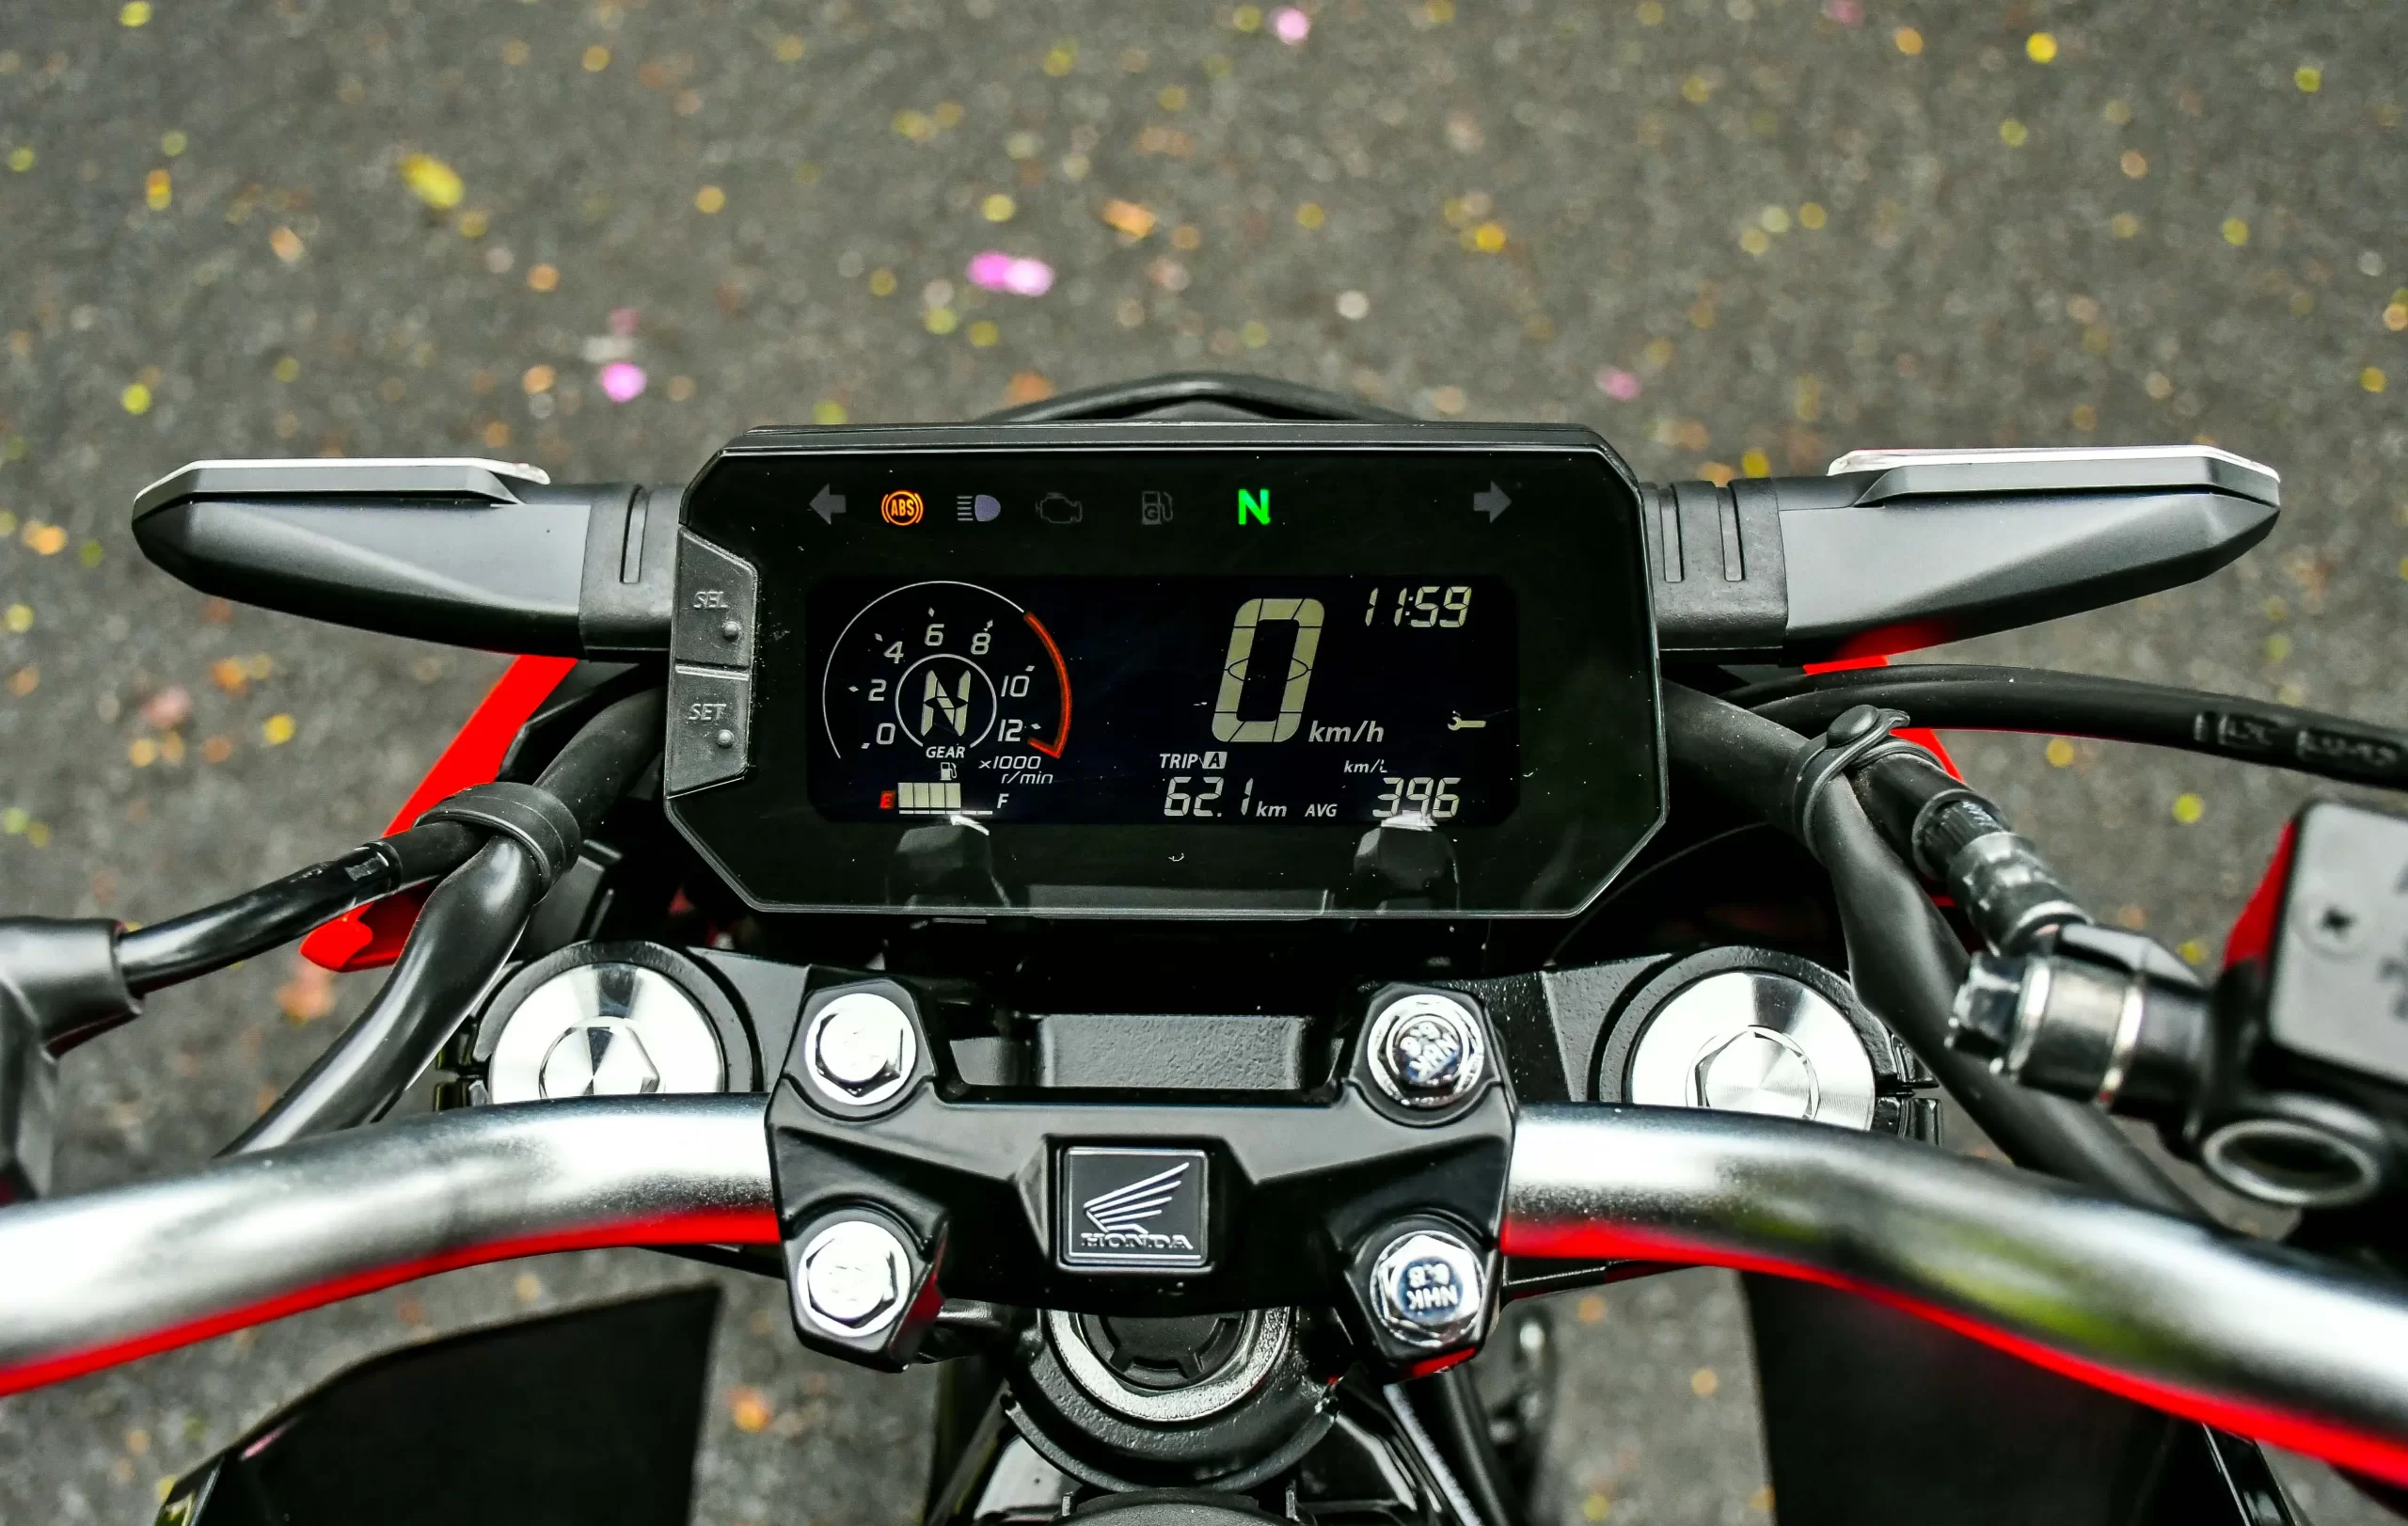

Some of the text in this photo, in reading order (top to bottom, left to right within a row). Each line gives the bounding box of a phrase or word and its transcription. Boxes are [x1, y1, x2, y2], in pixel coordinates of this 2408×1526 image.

[890, 499, 915, 517] ABS
[1239, 489, 1270, 525] N
[692, 590, 730, 610] SEL
[1366, 586, 1471, 628] 11:59
[925, 624, 943, 645] 6
[971, 633, 990, 654] 8
[884, 642, 903, 663] 4
[1212, 598, 1384, 742] 0 km/h
[869, 679, 886, 701] 2
[1001, 676, 1029, 697] 10
[687, 703, 727, 723] SET
[921, 671, 971, 736] N
[877, 723, 895, 744] 0
[998, 720, 1022, 741] 12
[927, 746, 965, 758] GEAR
[979, 756, 1041, 769] x1000
[1160, 753, 1225, 769] TRIP A
[1002, 771, 1053, 784] r/min
[879, 791, 895, 809] E
[997, 794, 1008, 808] F
[1164, 777, 1287, 817] 62.1 km
[1305, 804, 1337, 817] AVG
[1081, 1232, 1193, 1250] HONDA
[1406, 1284, 1459, 1311] NHK
